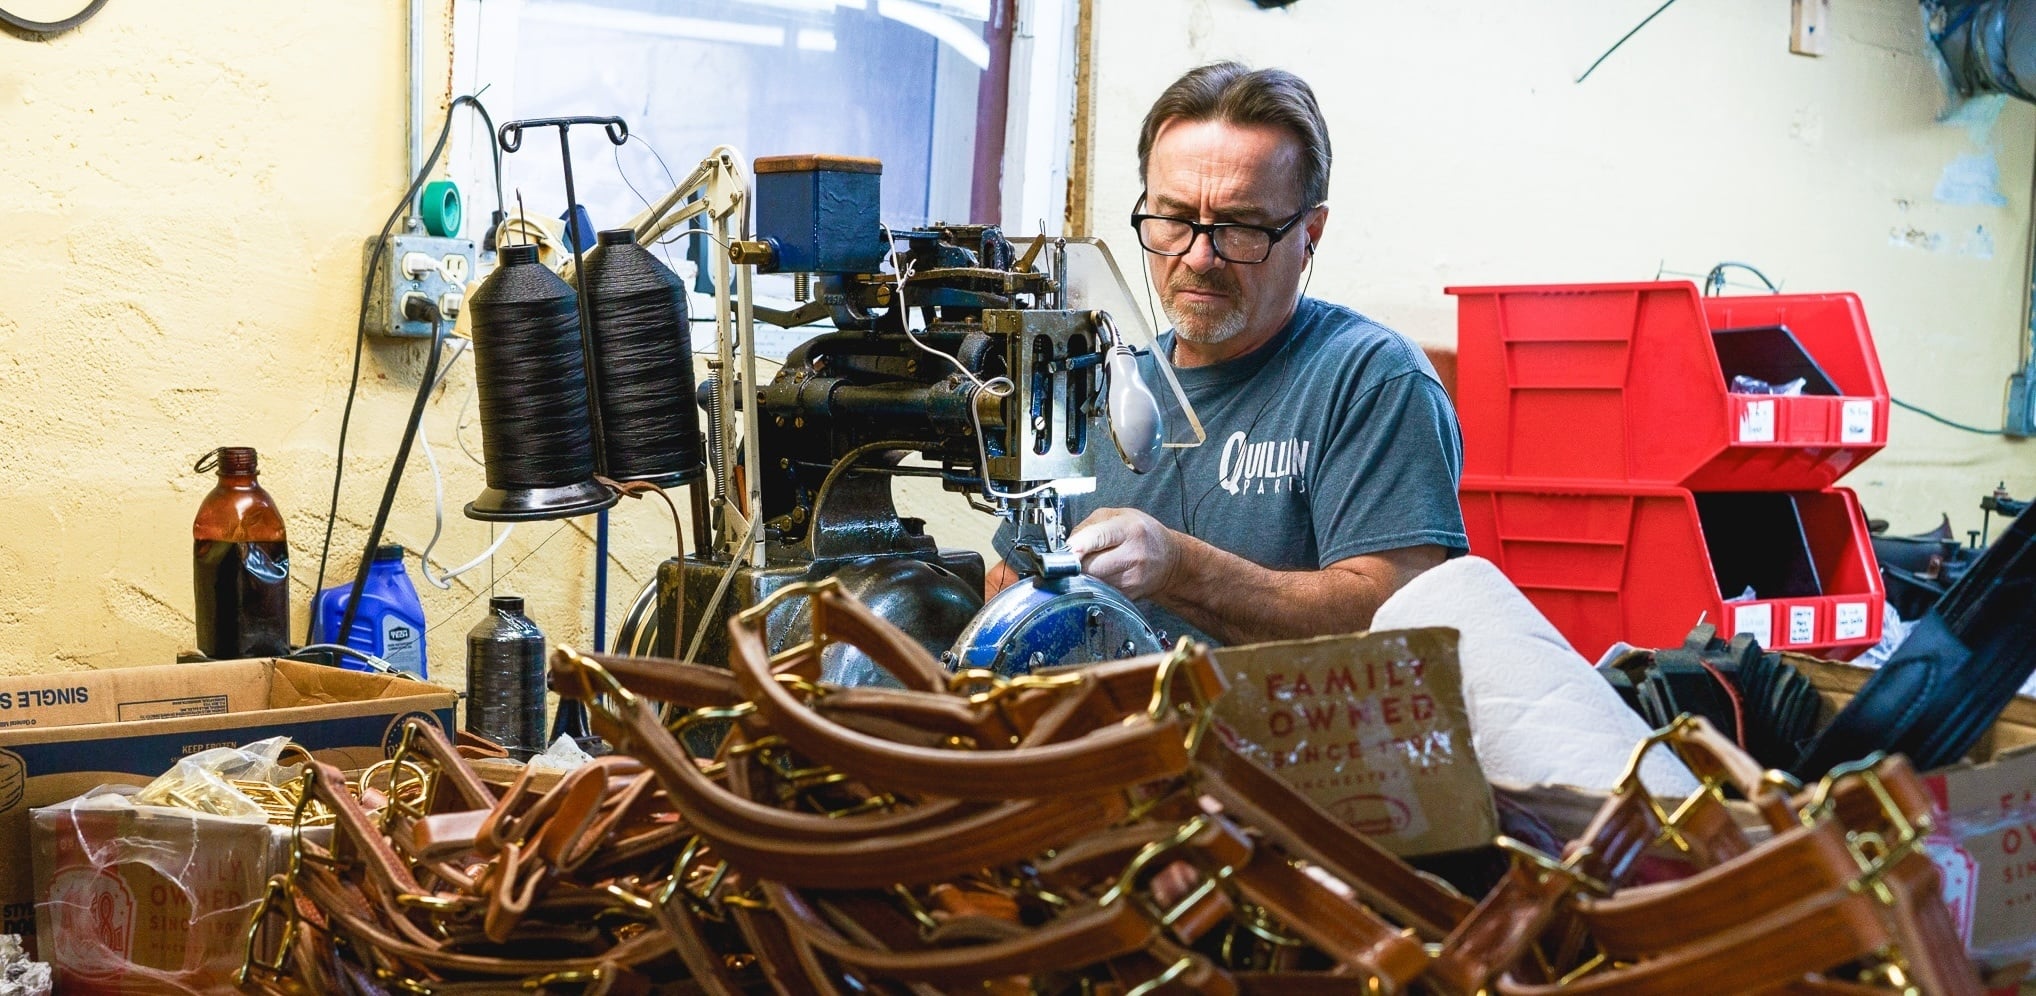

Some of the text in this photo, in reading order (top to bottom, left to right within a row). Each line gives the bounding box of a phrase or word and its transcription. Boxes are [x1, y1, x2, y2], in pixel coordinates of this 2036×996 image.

[1219, 430, 1309, 496] QUILLIN
[17, 686, 88, 708] SINGLE
[1265, 657, 1427, 701] FAMILY
[1268, 693, 1436, 738] OWNED
[182, 744, 204, 754] KEEP
